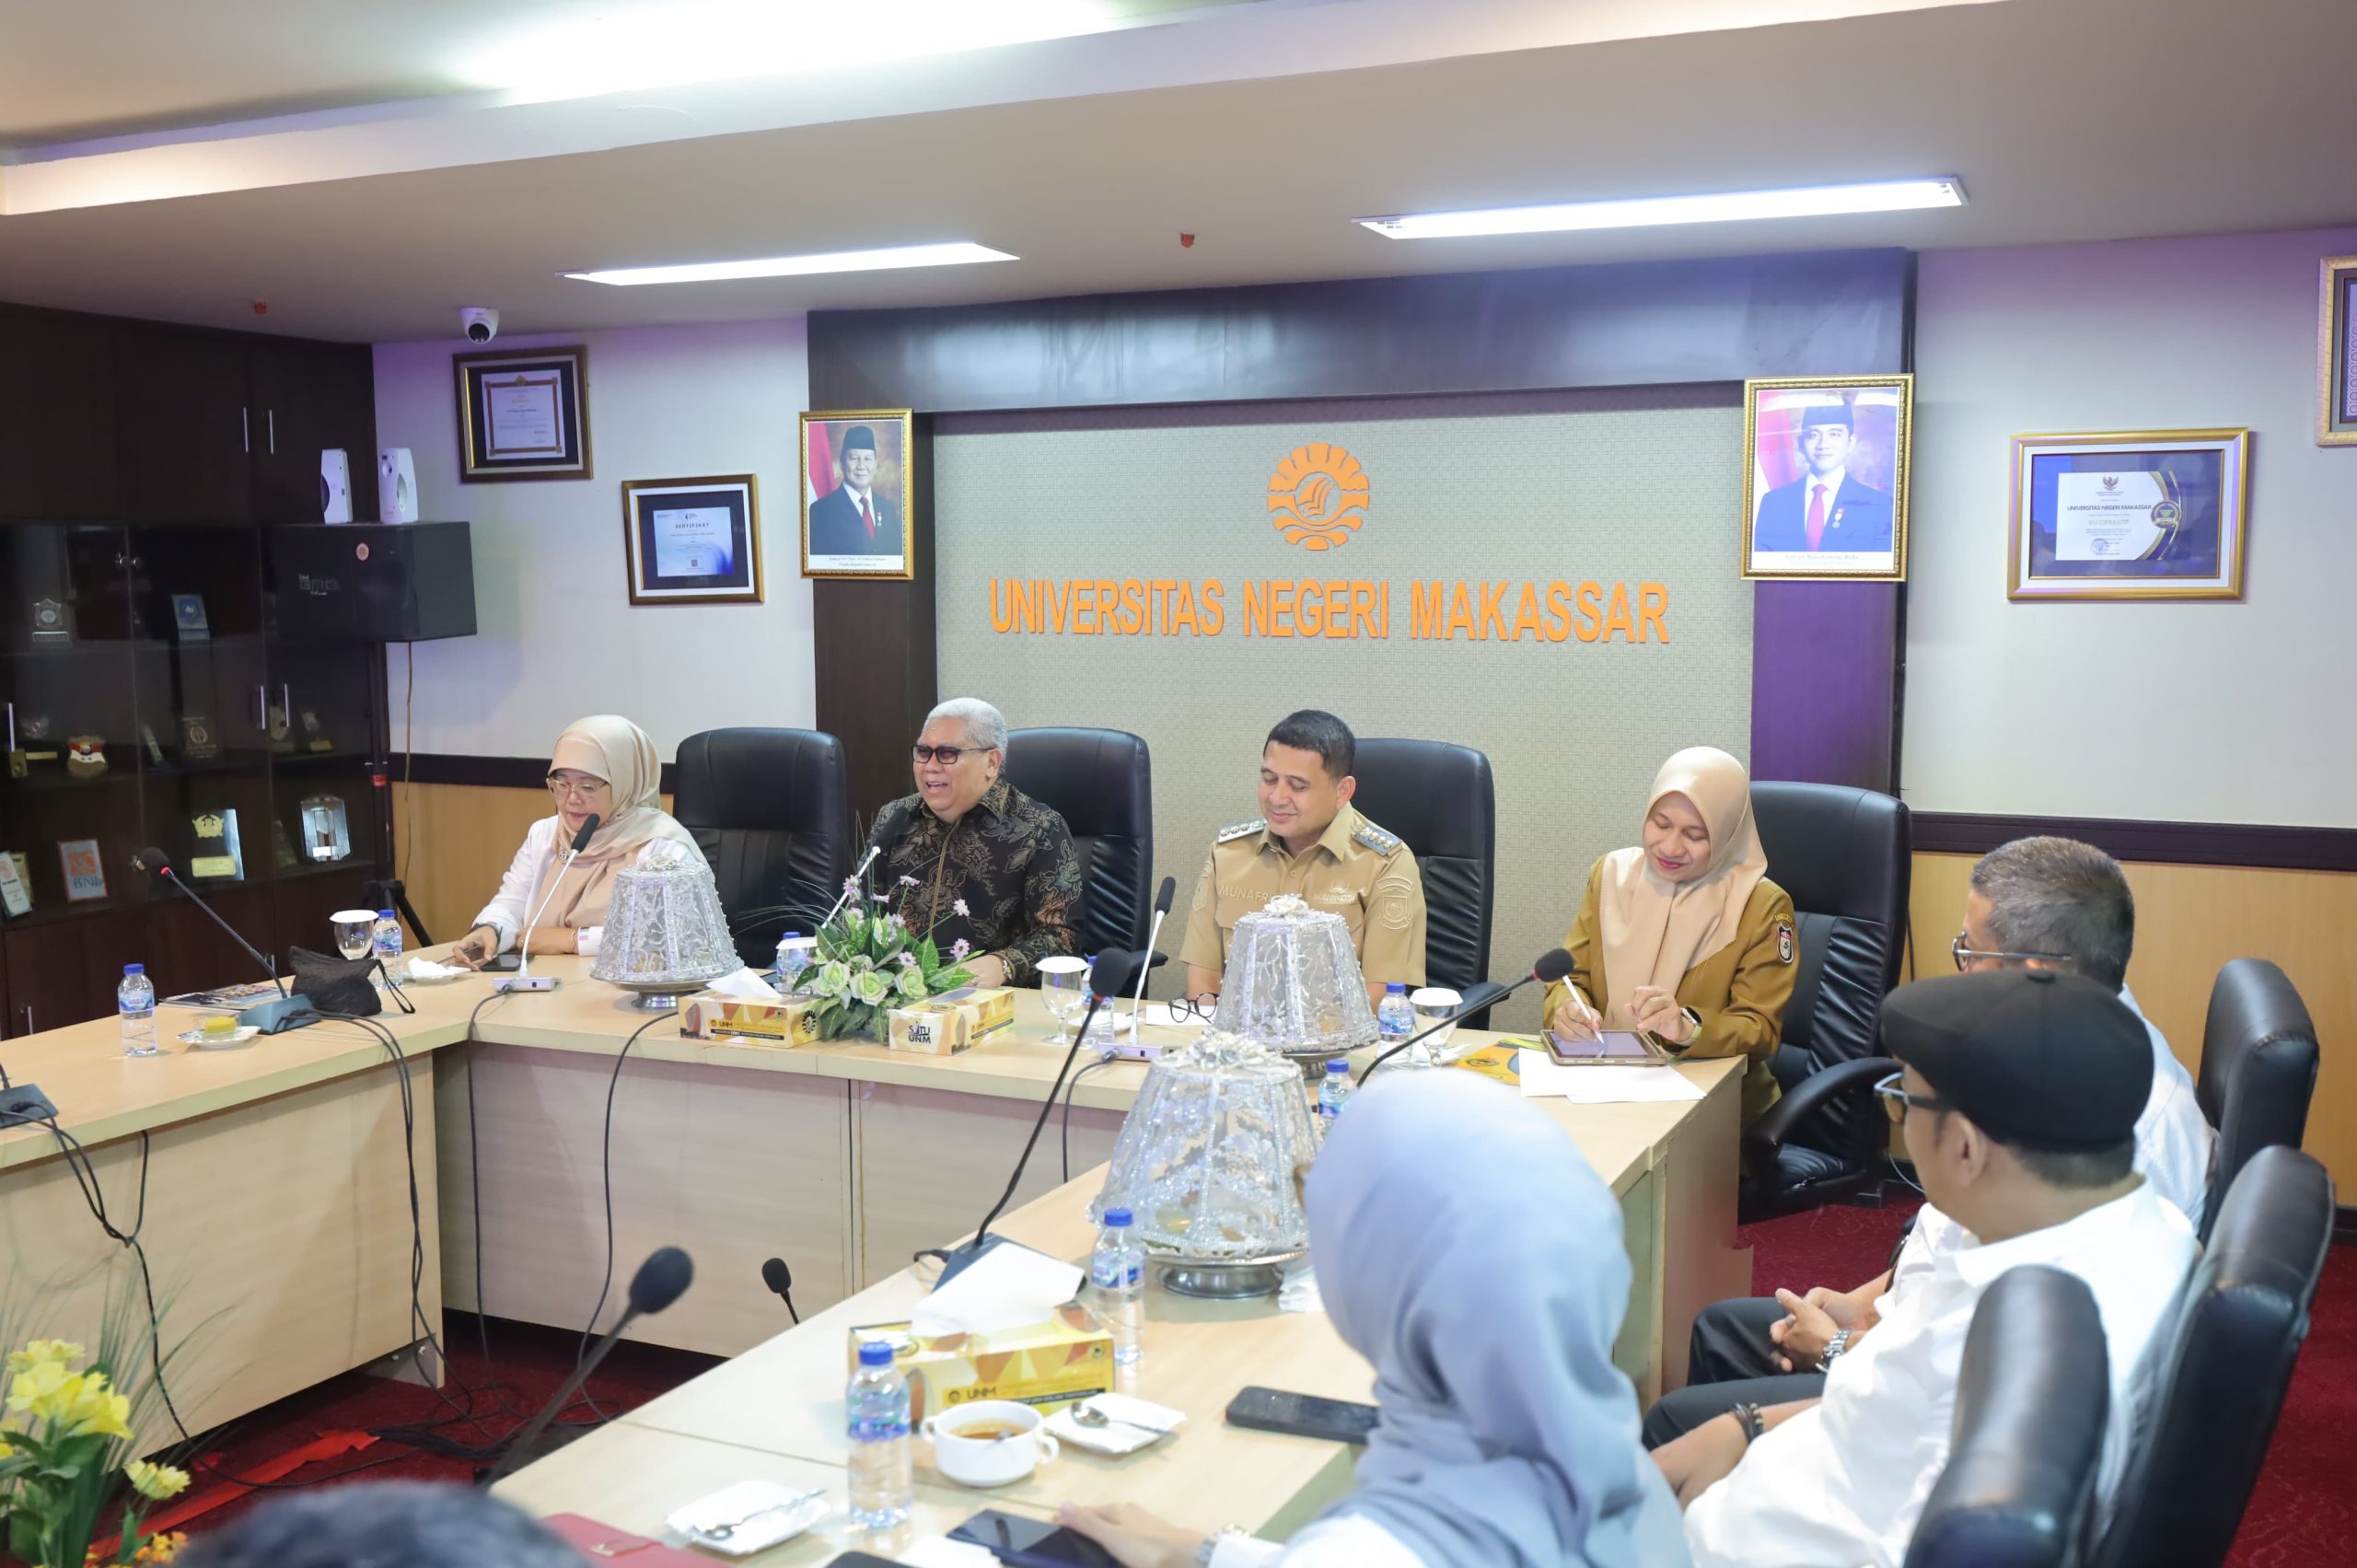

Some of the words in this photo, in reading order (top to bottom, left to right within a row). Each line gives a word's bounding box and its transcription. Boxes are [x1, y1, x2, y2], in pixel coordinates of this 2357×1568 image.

[989, 578, 1225, 636] UNIVERSITAS
[1243, 579, 1389, 638] NEGERI
[1411, 581, 1671, 644] MAKASSAR
[74, 876, 101, 889] BNI
[909, 1034, 932, 1044] UNM
[967, 1387, 997, 1400] UNM
